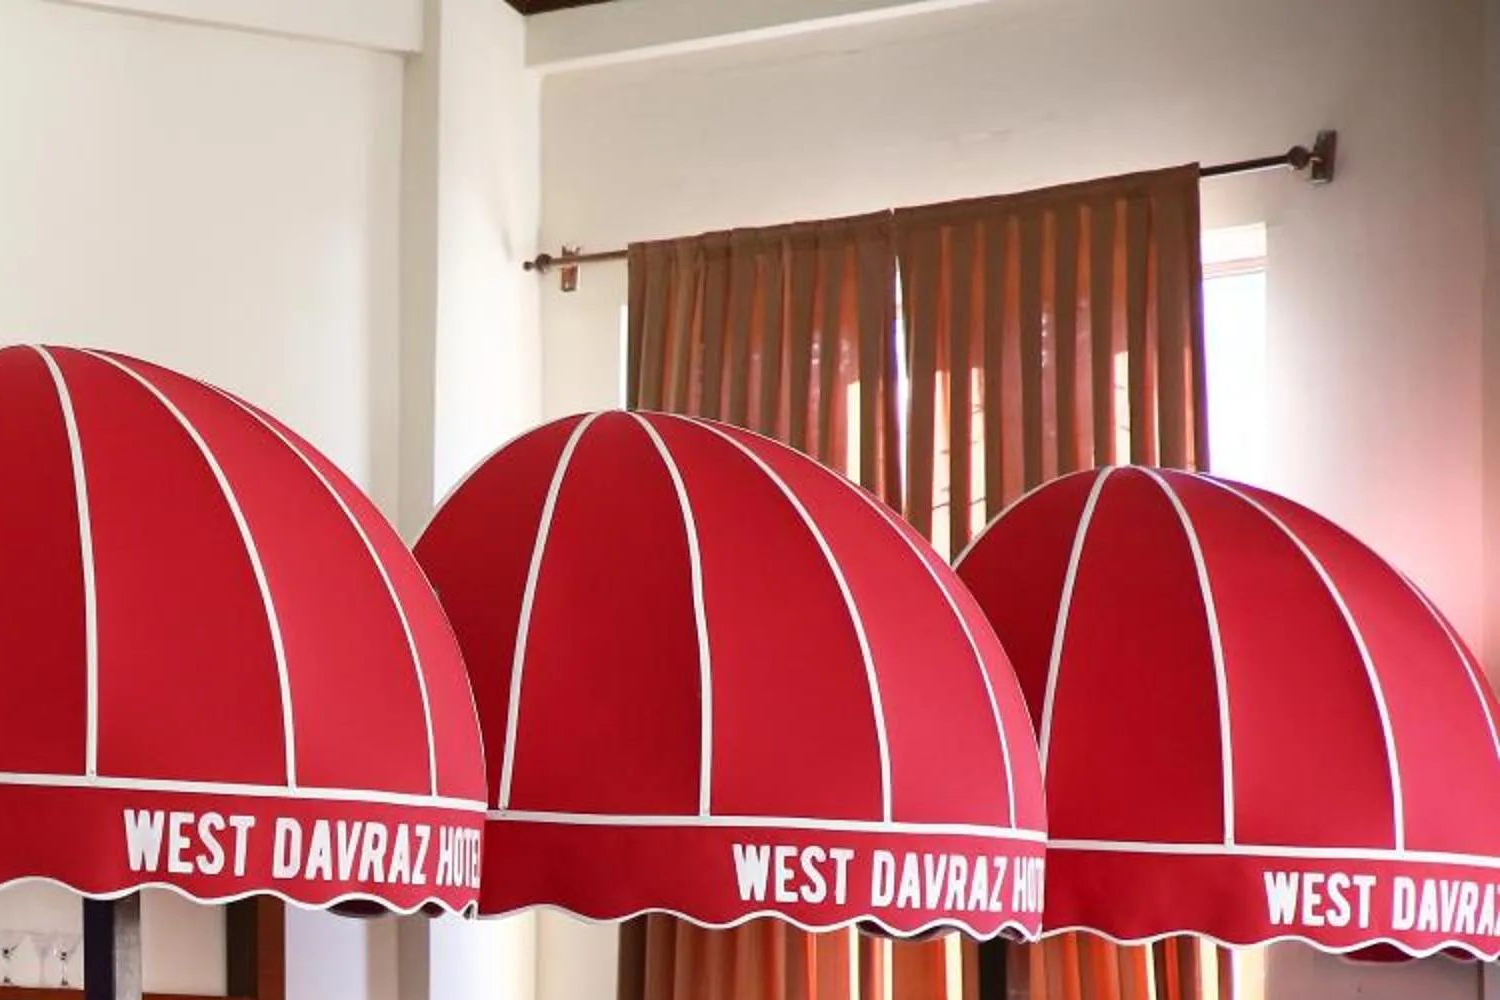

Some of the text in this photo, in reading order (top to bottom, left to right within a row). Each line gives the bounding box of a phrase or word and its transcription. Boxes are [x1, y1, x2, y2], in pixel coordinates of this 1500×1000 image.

[123, 809, 256, 877] WEST
[272, 817, 432, 885] DAVRAZ
[732, 843, 1045, 914] WEST DAVRAZ HOT
[1263, 871, 1377, 929] WEST
